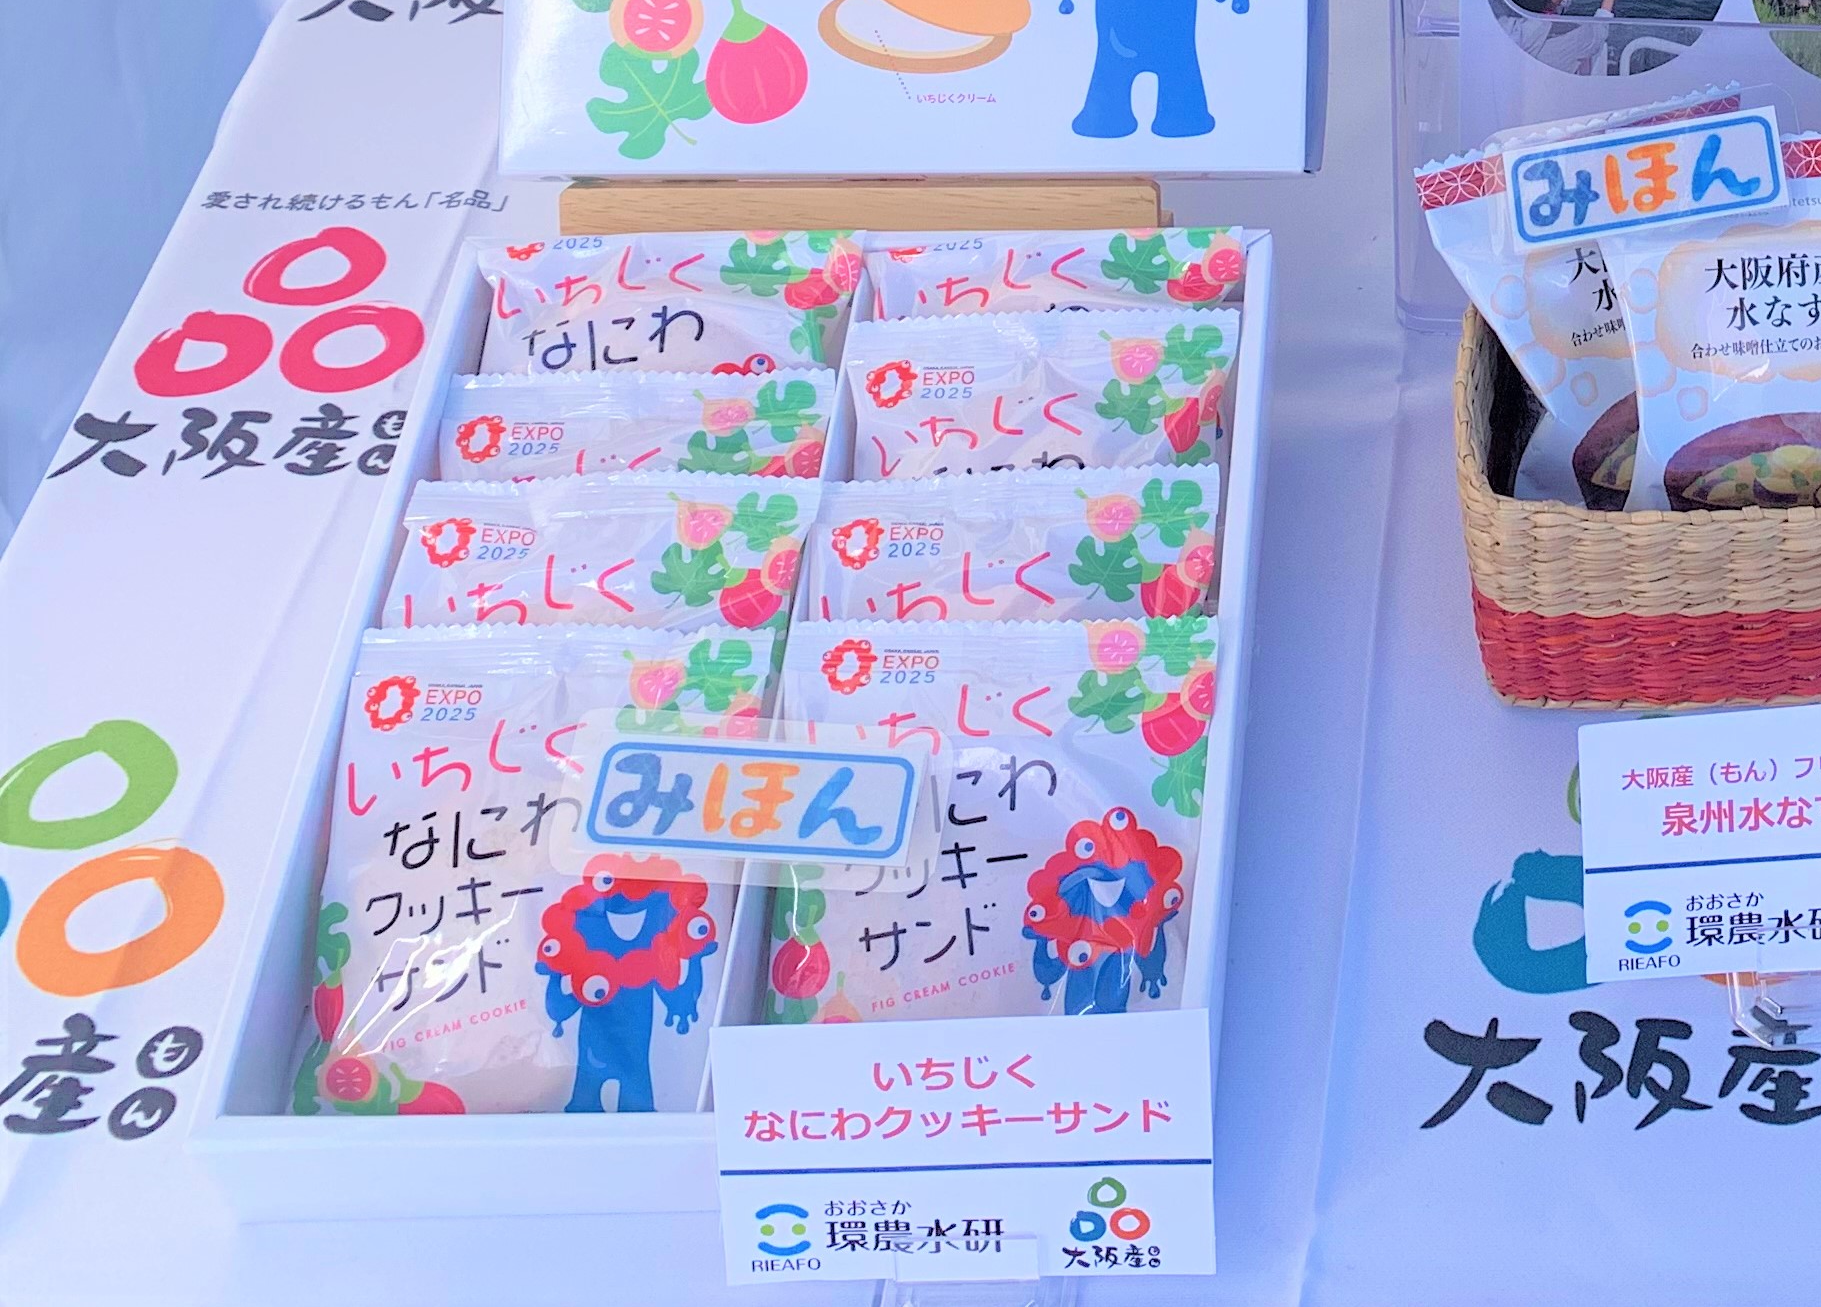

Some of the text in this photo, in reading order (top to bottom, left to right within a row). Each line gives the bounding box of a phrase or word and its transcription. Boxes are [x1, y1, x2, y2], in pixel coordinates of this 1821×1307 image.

[916, 93, 997, 105] いちじくクリーム
[1519, 133, 1761, 228] みほん
[496, 245, 706, 320] いちじく
[521, 304, 705, 372] なにわ
[923, 369, 976, 387] EXPO
[919, 386, 974, 400] 2025
[511, 426, 565, 442] EXPO
[871, 392, 1085, 478] いちじく
[507, 442, 561, 457] 2025
[481, 527, 538, 546] EXPO
[889, 525, 944, 542] EXPO
[475, 545, 531, 561] 2025
[887, 542, 942, 559] 2025
[882, 654, 940, 670] EXPO
[879, 670, 937, 685] 2025
[424, 688, 484, 706] EXPO
[420, 707, 477, 723] 2025
[347, 718, 588, 818] いちじく
[604, 751, 883, 846] みほん
[930, 755, 1058, 834] にわ
[383, 792, 583, 871] なにわ
[365, 876, 544, 936] クッキー
[1684, 890, 1766, 912] おおさか
[858, 902, 996, 972] サンド
[1617, 953, 1683, 974] RIEAFO
[871, 963, 1016, 1013] FIG CREAM COOKIE
[414, 998, 528, 1043] CREAM COOKIE
[872, 1051, 1039, 1094] いちじく
[743, 1100, 1174, 1144] なにわクッキーサンド
[823, 1199, 913, 1217] おおさか
[825, 1217, 1006, 1255] 環農水研
[750, 1257, 822, 1273] RIEAFO
